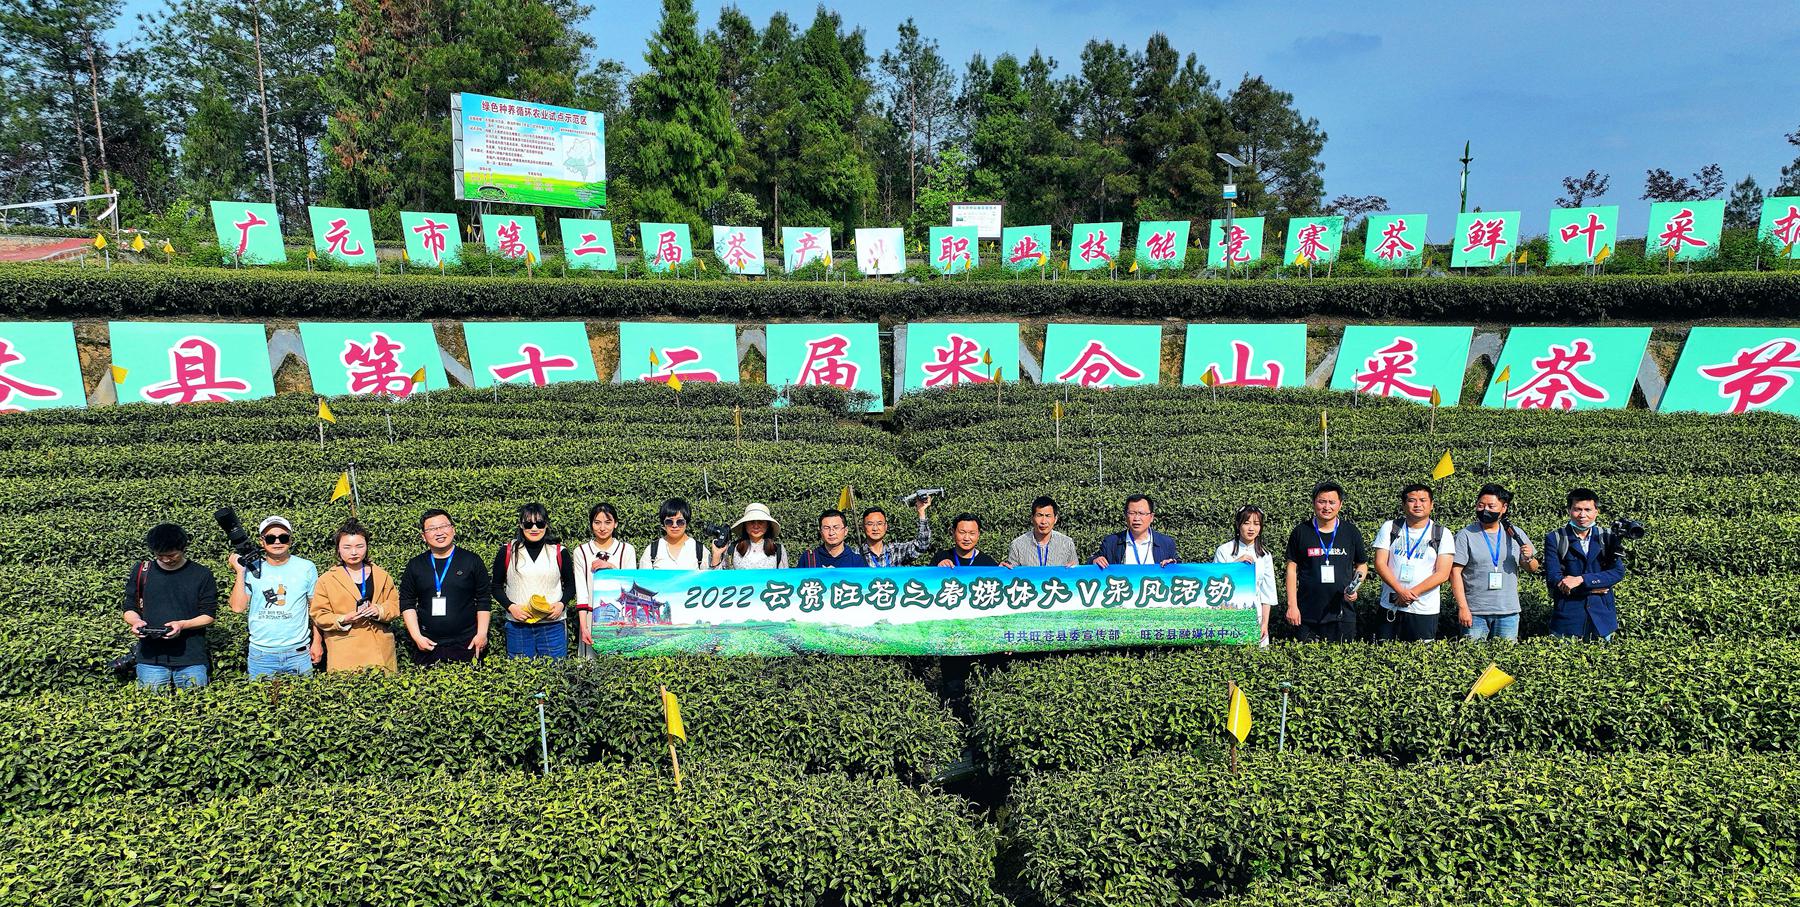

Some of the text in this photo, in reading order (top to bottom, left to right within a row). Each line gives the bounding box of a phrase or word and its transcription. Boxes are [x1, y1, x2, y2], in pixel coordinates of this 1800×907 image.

[481, 99, 588, 126] 绿色种养循环农业试点示范区
[1394, 548, 1411, 558] WIT
[1003, 627, 1242, 642] 中共旺苍县委宣传部 旺苍县融媒体中心
